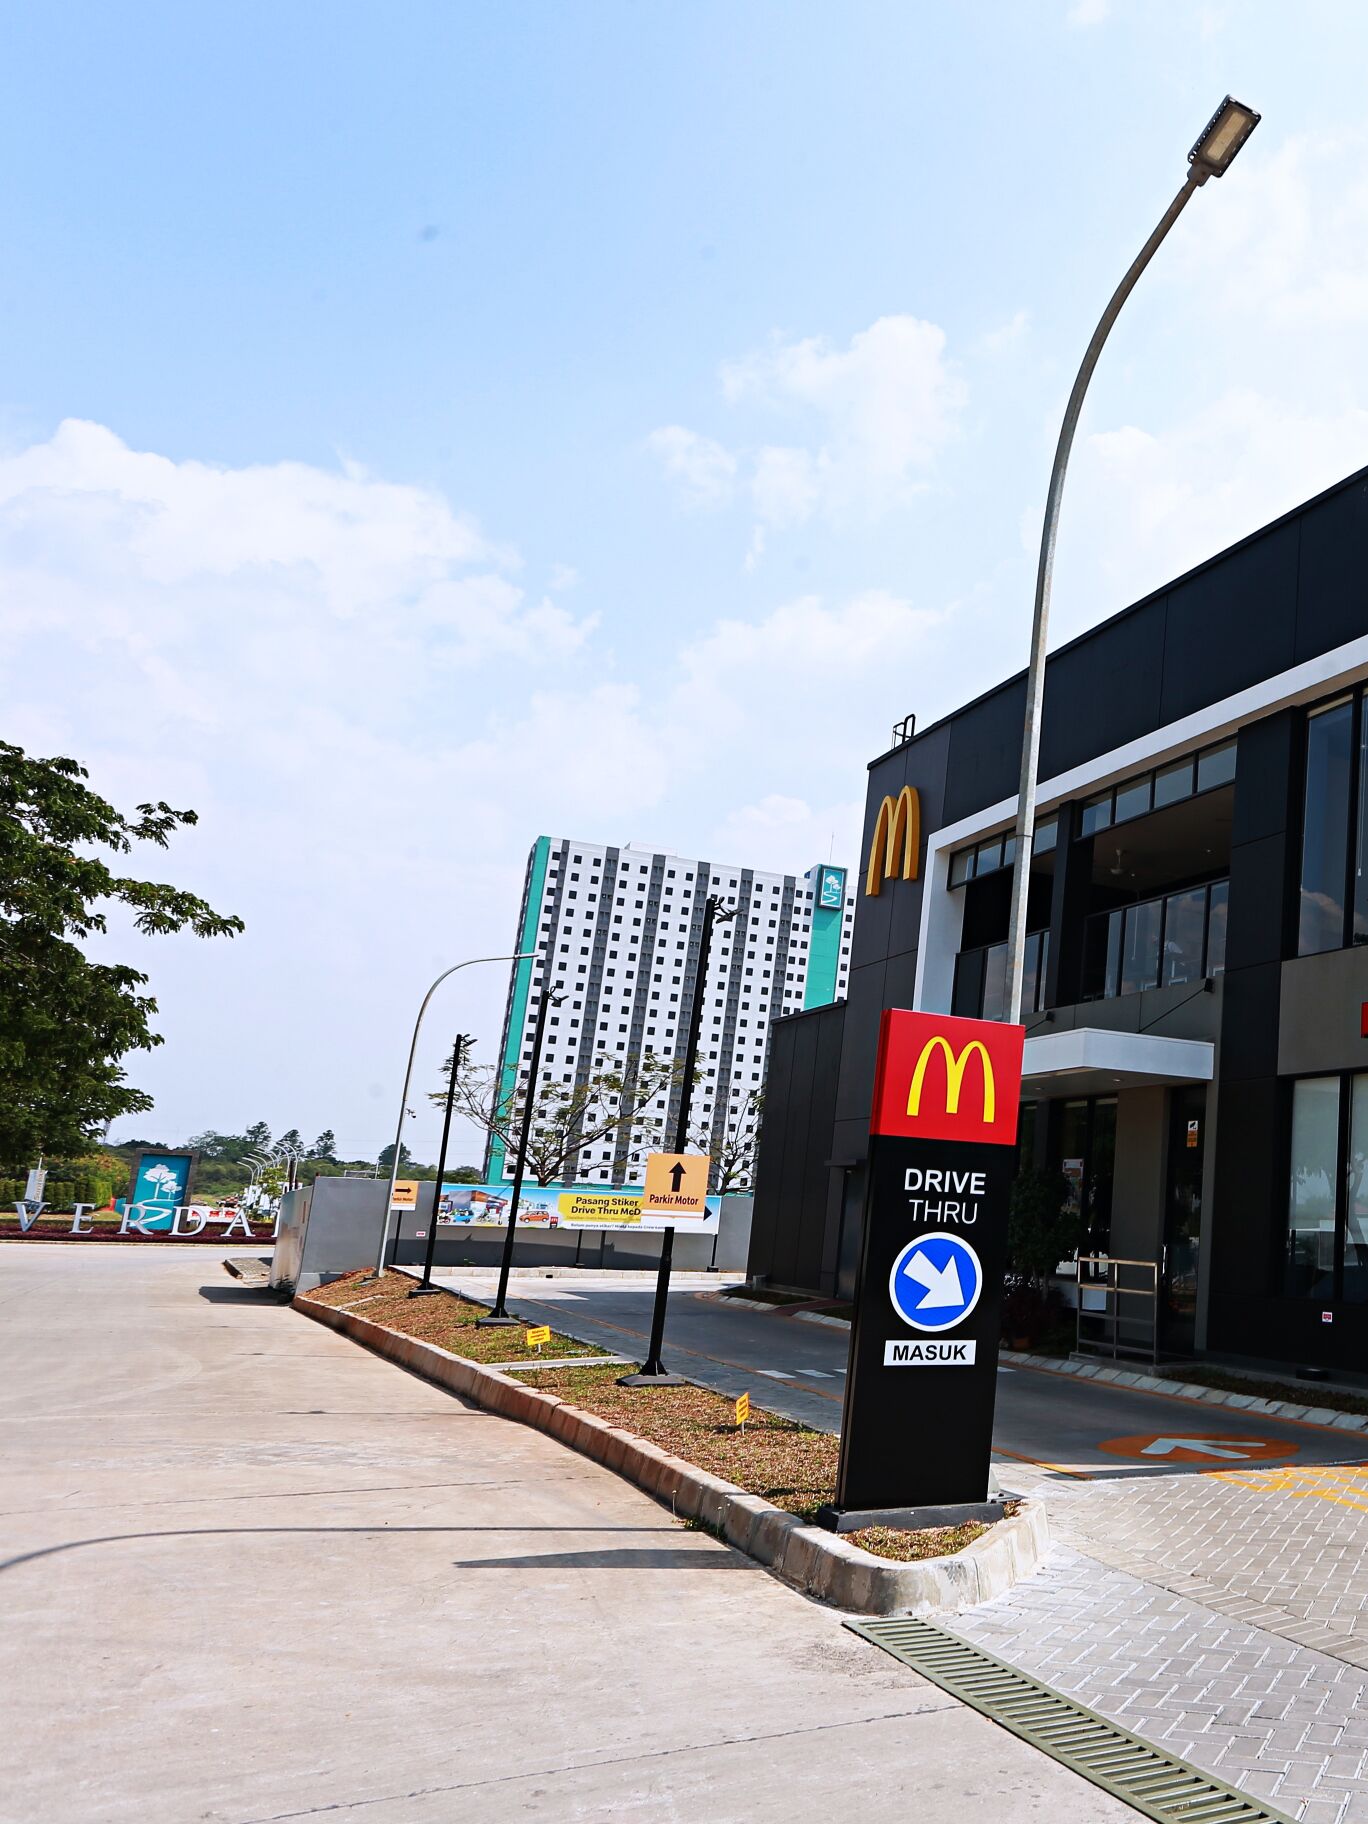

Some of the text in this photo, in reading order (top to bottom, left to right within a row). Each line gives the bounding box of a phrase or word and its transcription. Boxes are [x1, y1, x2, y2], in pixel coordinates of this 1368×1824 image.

[904, 1168, 986, 1196] DRIVE
[576, 1196, 638, 1207] Pasang Stiker
[649, 1194, 700, 1206] Parkir Motor
[12, 1201, 278, 1238] VERDA
[571, 1205, 641, 1216] Drive Thru McD
[909, 1199, 978, 1225] THRU
[892, 1343, 967, 1362] MASUK
